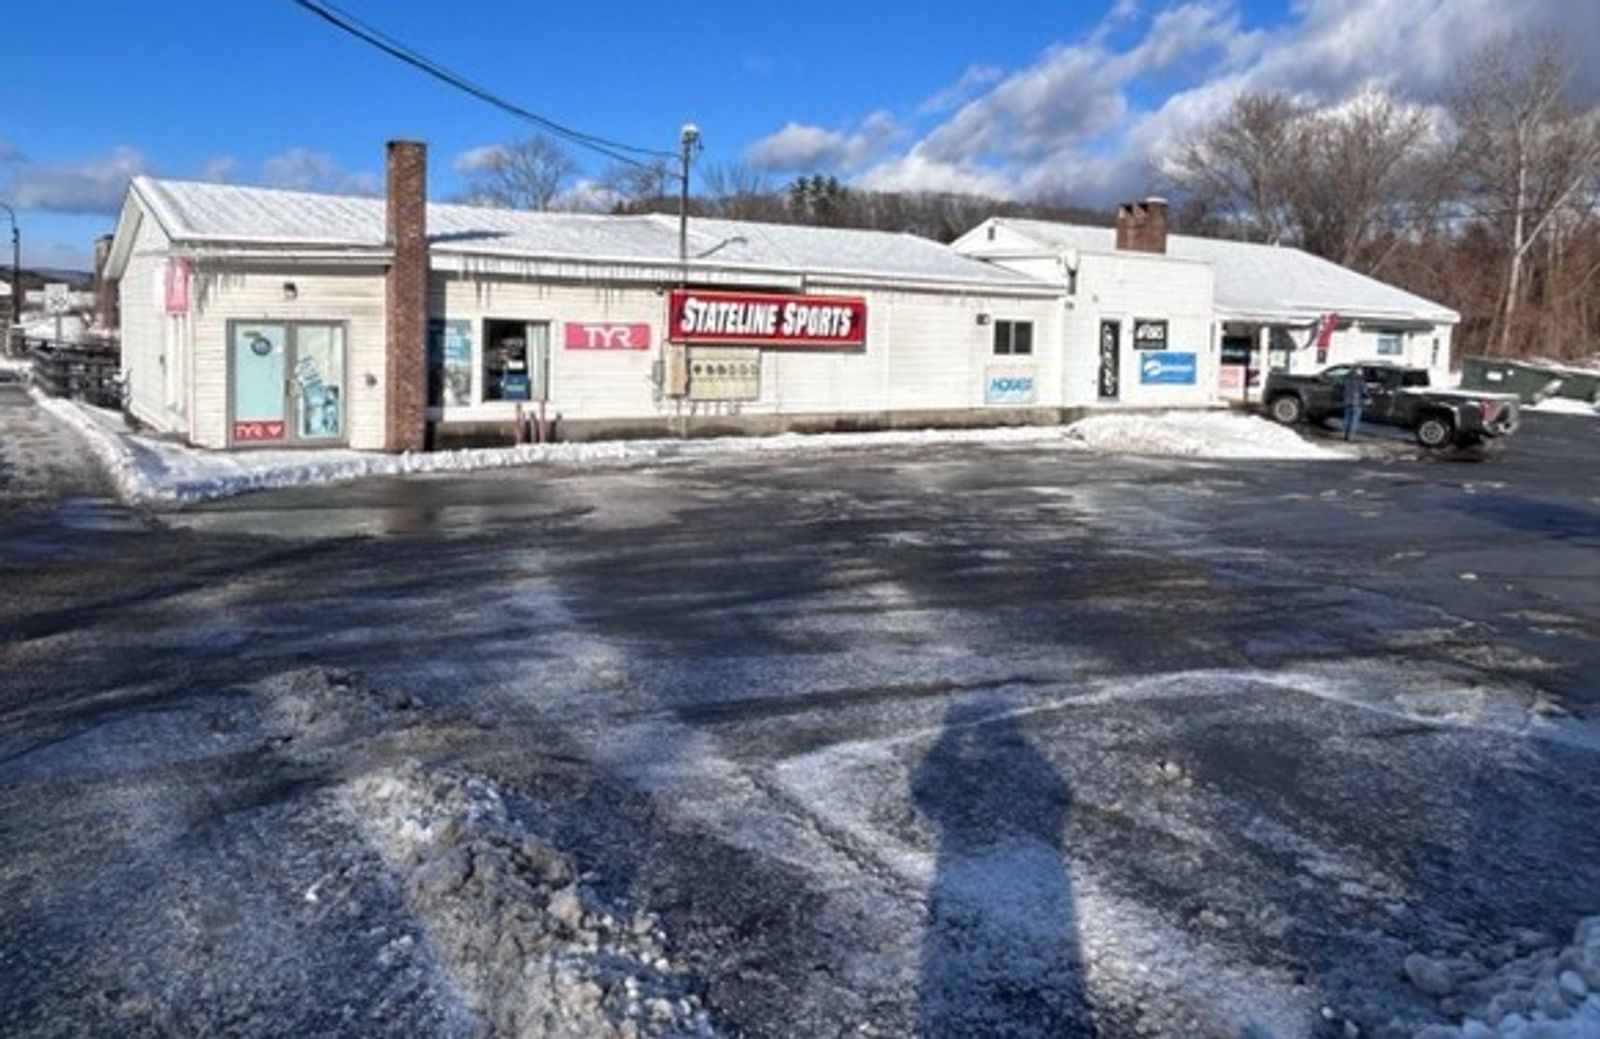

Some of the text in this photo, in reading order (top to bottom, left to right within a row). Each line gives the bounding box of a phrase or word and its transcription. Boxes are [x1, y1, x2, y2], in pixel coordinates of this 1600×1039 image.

[681, 297, 853, 336] STATELINE SPORTS
[583, 326, 632, 348] TYR
